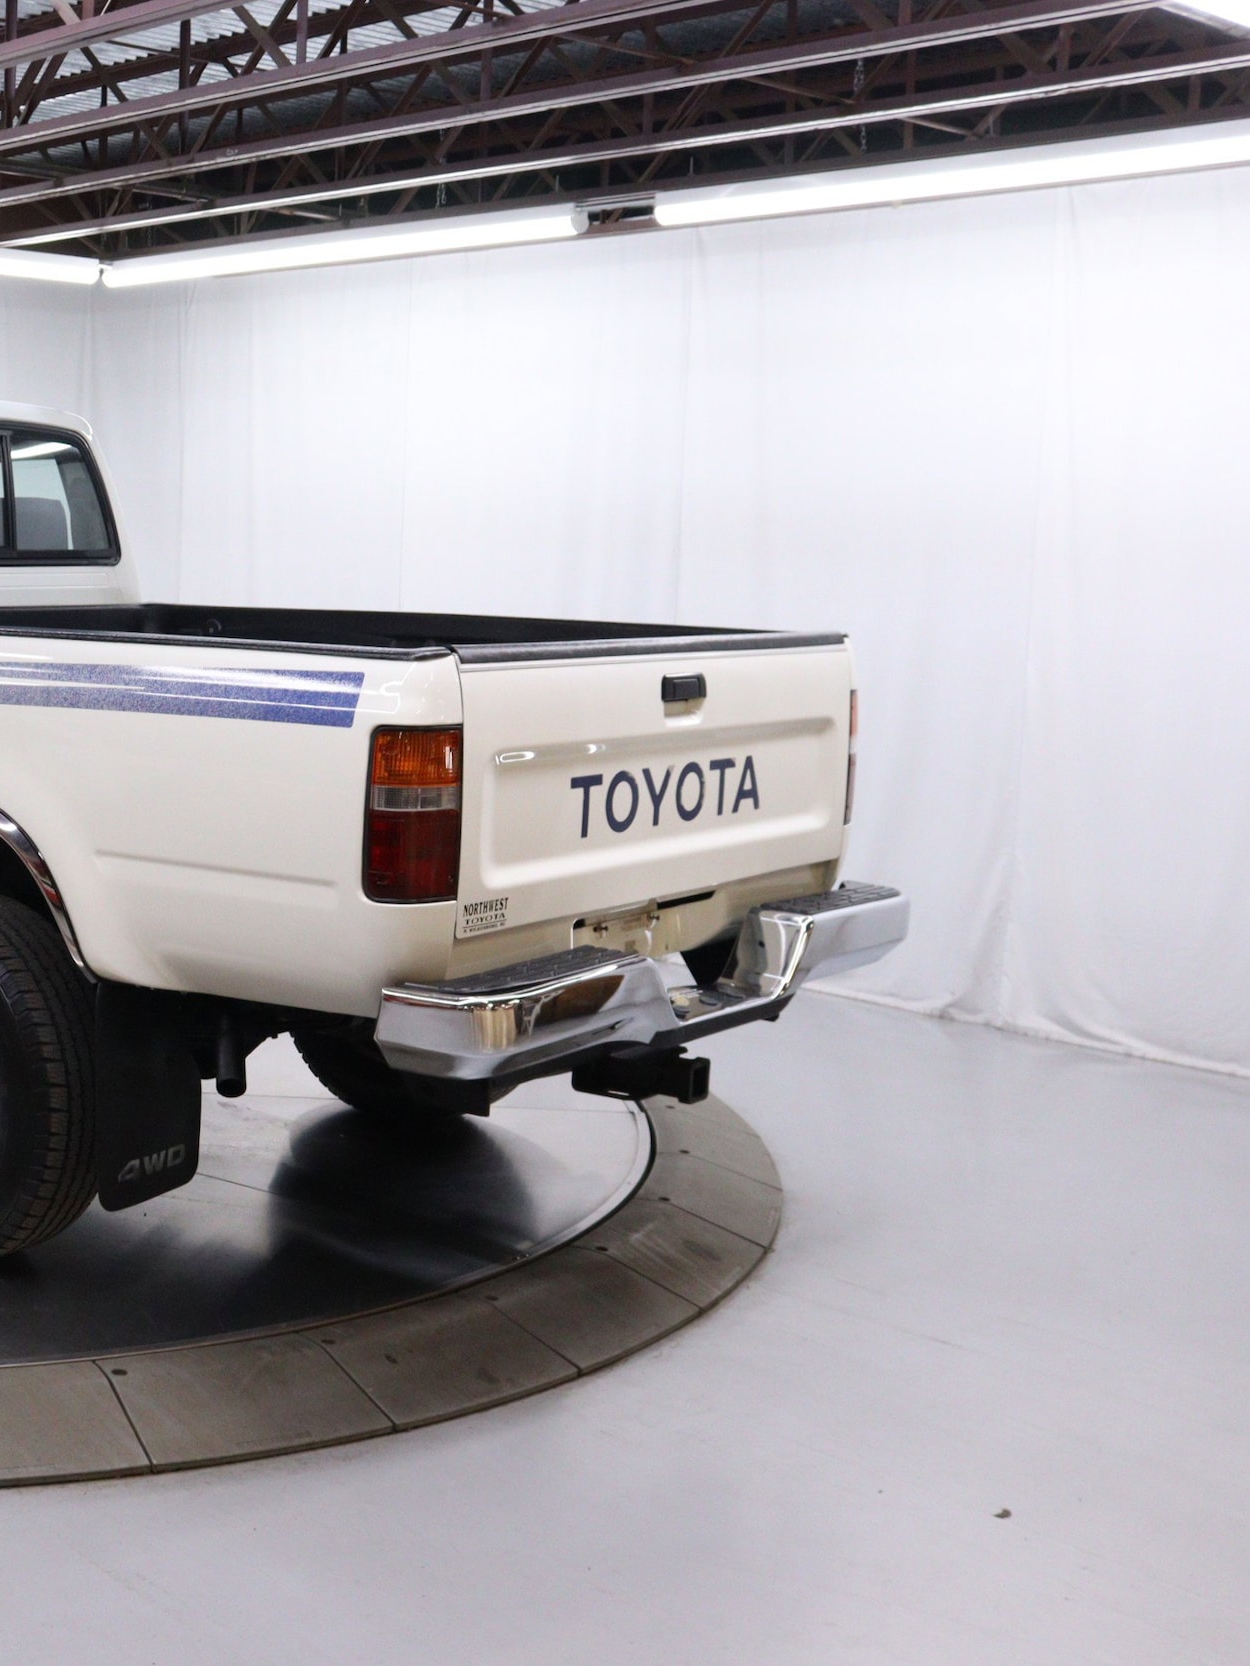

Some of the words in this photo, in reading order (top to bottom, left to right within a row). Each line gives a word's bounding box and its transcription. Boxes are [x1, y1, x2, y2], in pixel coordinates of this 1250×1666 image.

[570, 755, 760, 838] TOYOTA
[463, 897, 508, 917] NORTHWEST
[465, 912, 506, 925] TOYOTA
